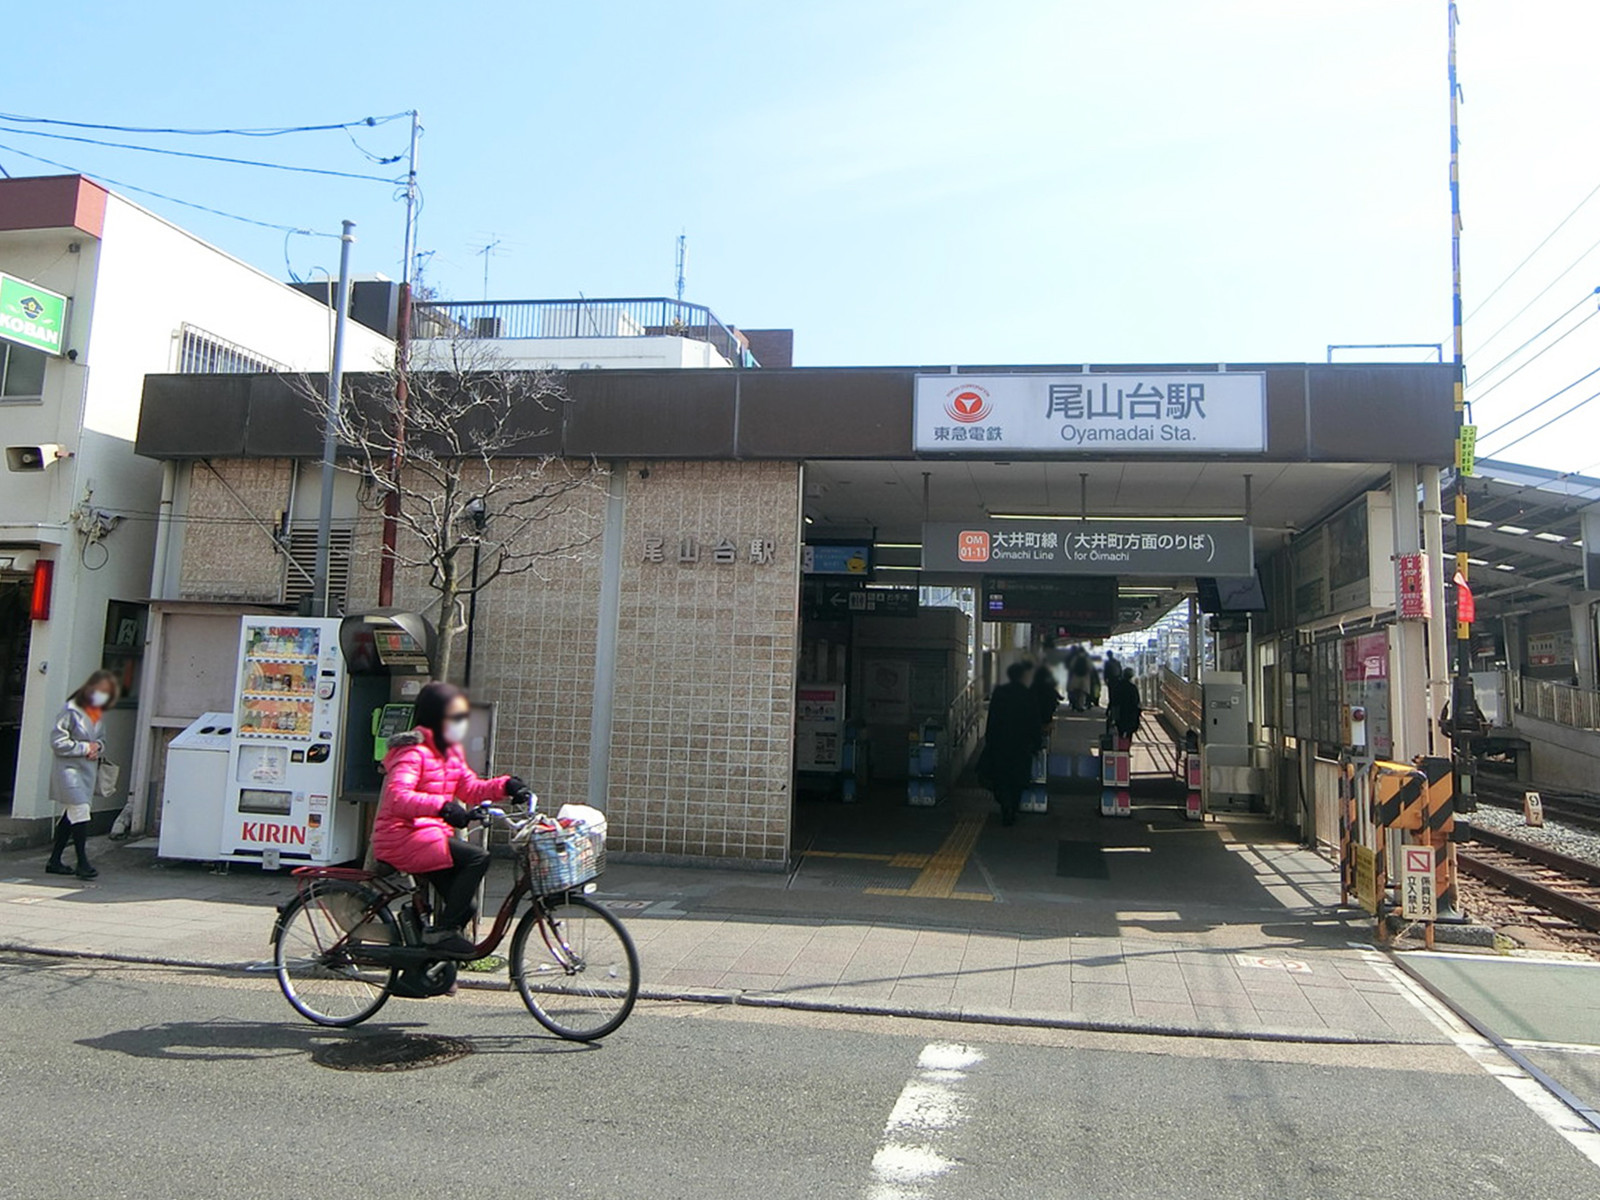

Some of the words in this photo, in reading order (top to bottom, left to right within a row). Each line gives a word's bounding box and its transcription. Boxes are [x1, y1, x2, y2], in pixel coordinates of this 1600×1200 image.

[0, 313, 58, 344] KOBAN
[1045, 382, 1207, 420] 尾山台駅
[934, 426, 1003, 441] 東急電鉄
[1060, 424, 1154, 445] Oyamadai
[1160, 424, 1197, 441] Sta.
[640, 536, 776, 564] 尾山台駅
[965, 536, 983, 545] OM
[992, 531, 1058, 549] 大井町線
[1033, 550, 1054, 560] Line
[1074, 551, 1087, 560] for
[241, 821, 307, 846] KIRIN
[1407, 875, 1418, 915] 立入禁止
[1421, 875, 1432, 915] 係員以外
